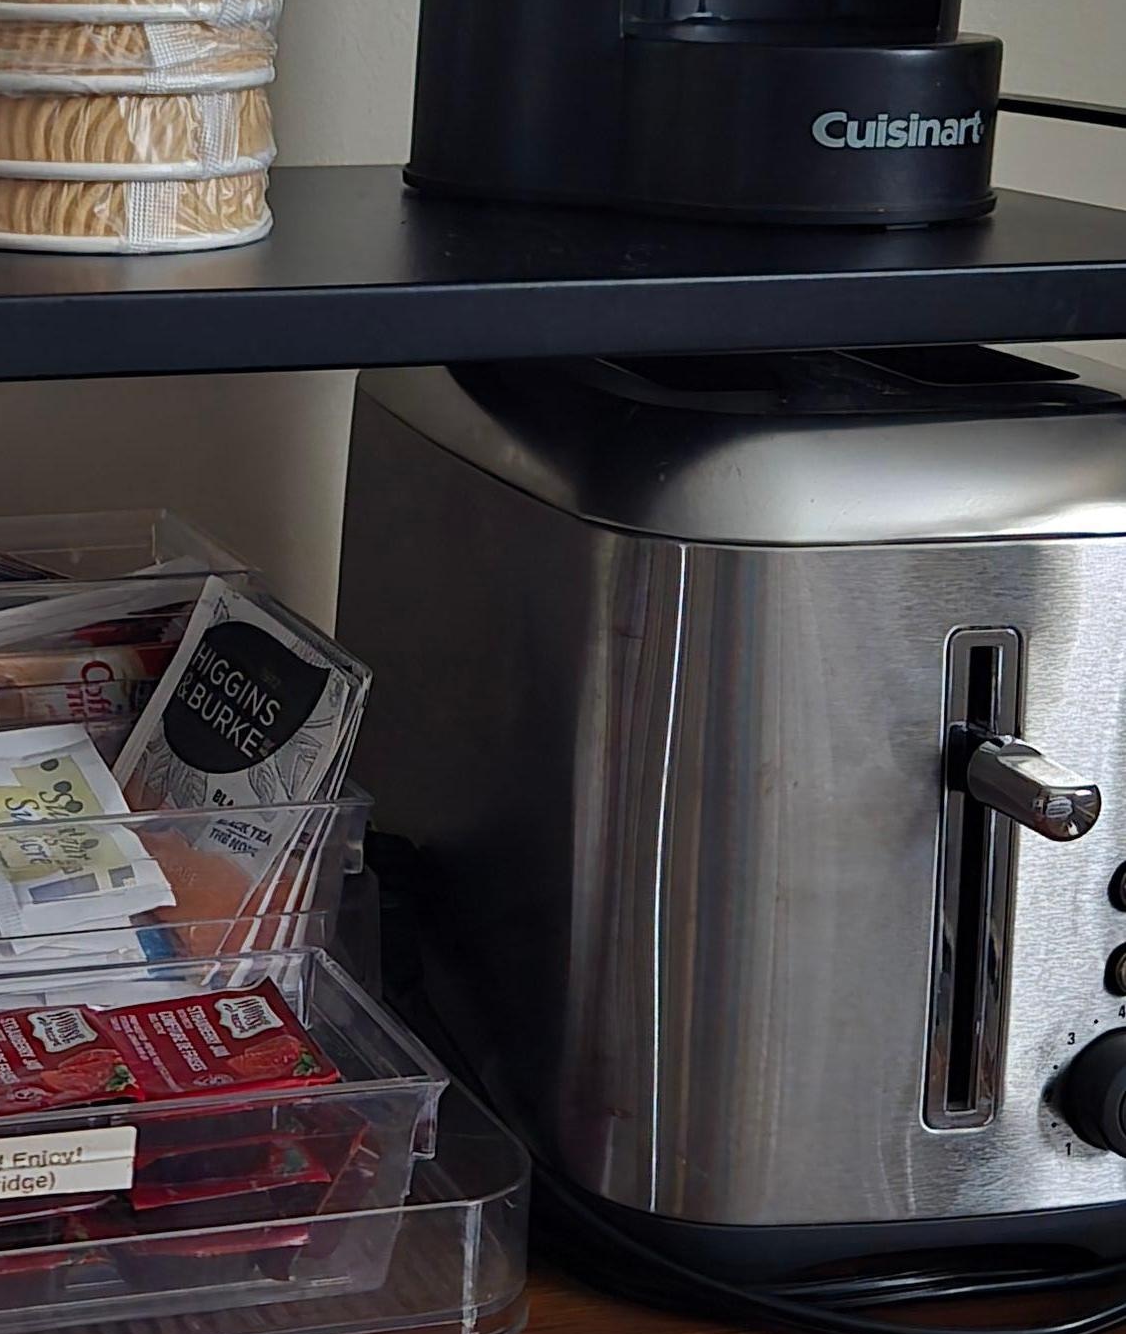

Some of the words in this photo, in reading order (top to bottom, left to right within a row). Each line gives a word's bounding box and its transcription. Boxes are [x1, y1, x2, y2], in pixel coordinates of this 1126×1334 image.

[812, 110, 982, 149] Cuisinart
[191, 640, 282, 727] HIGGINS
[249, 825, 273, 846] TEA
[1118, 1004, 1126, 1019] 4
[46, 1011, 86, 1044] HOUSE
[1066, 1031, 1076, 1046] 3
[1064, 1141, 1073, 1156] 1
